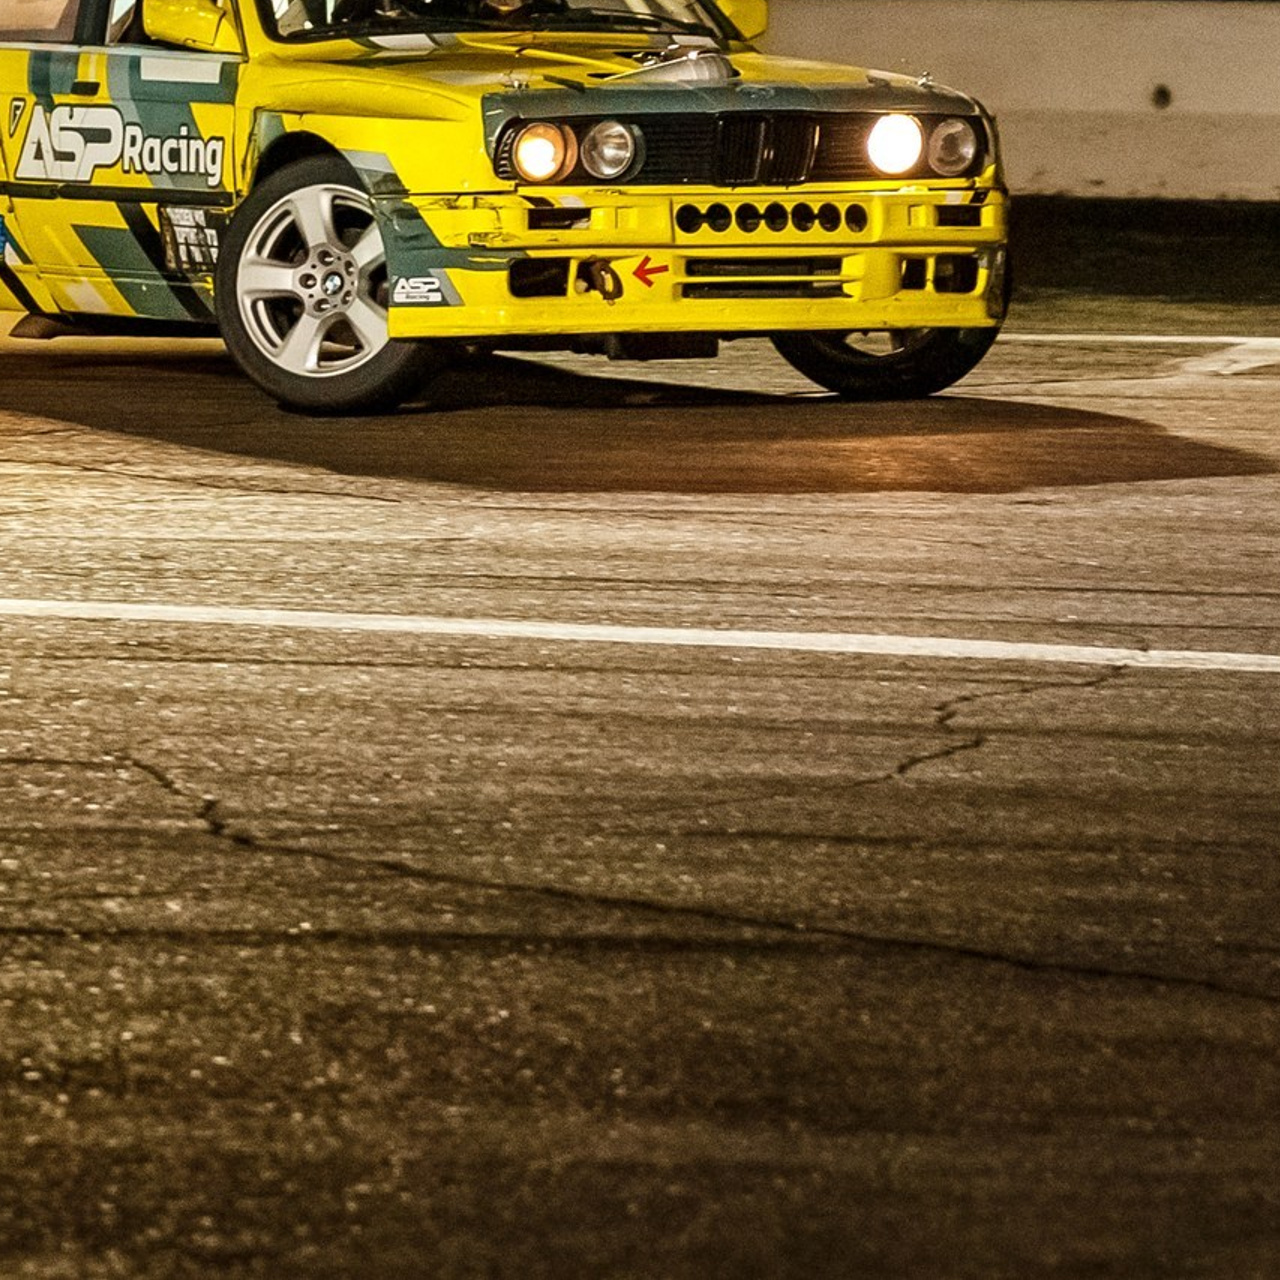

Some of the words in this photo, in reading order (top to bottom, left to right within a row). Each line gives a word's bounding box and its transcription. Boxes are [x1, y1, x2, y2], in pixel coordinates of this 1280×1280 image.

[15, 104, 124, 182] ASP
[122, 124, 224, 188] Racing
[394, 277, 440, 293] ASP
